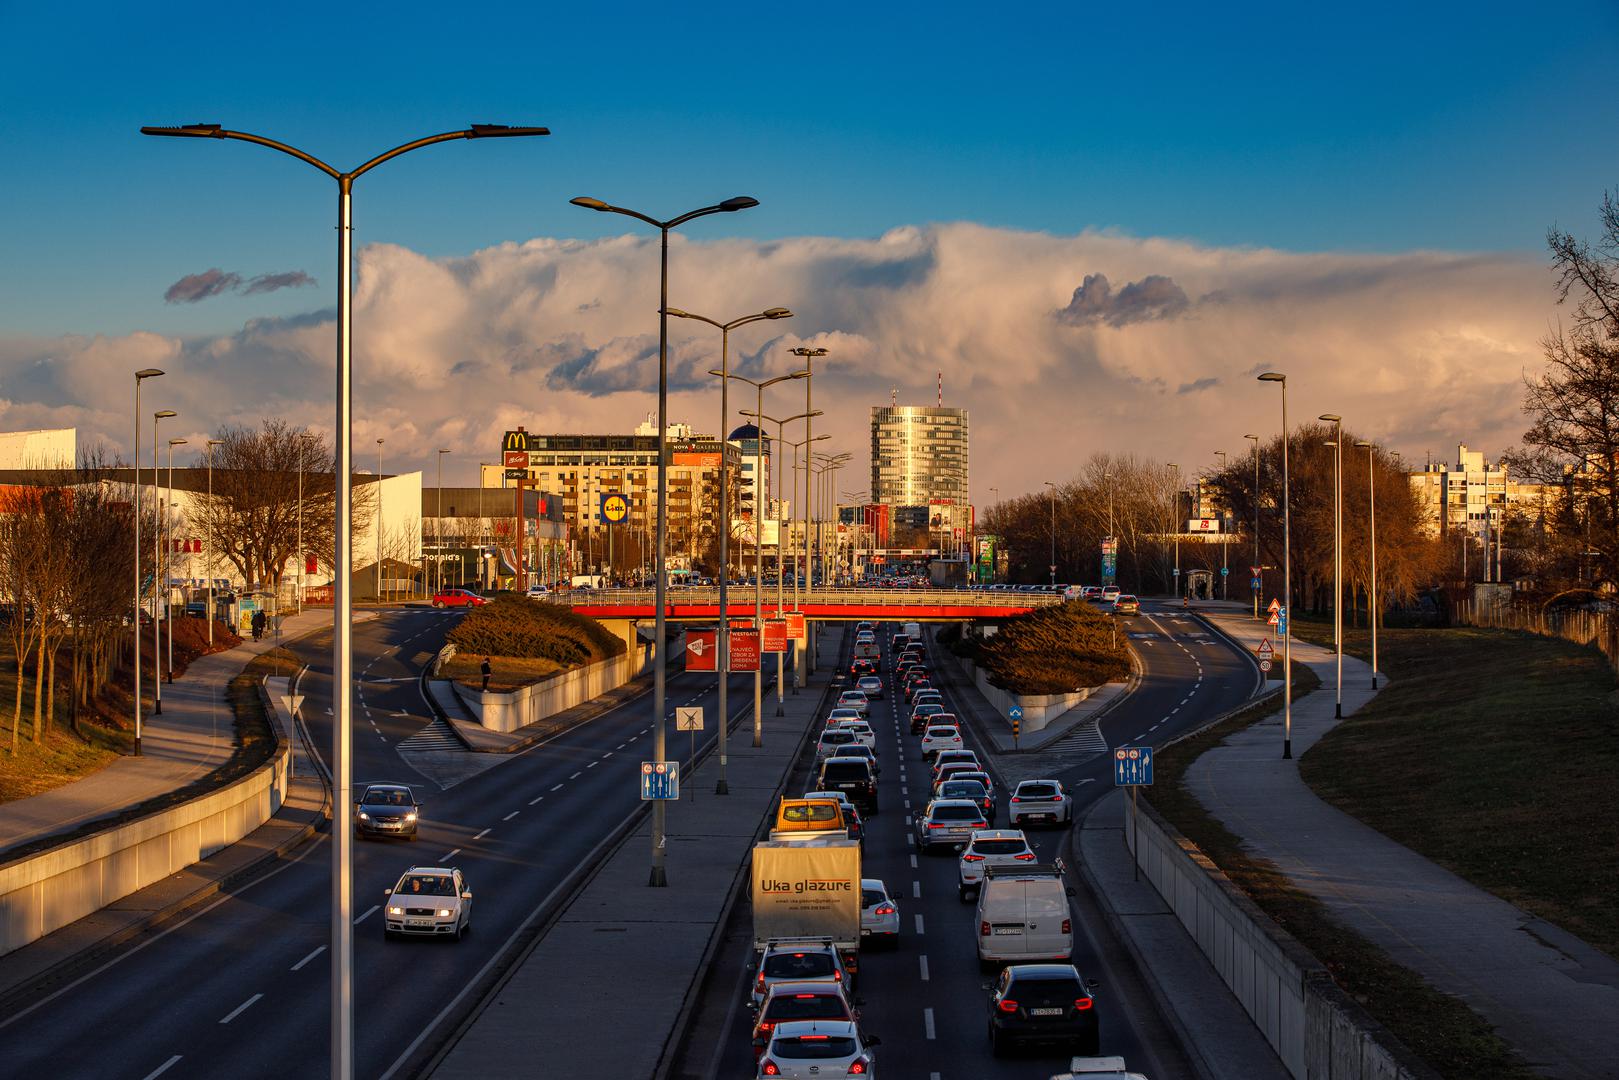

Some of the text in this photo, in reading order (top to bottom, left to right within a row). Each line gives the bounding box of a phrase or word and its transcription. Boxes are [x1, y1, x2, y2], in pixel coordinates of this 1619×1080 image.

[1261, 662, 1270, 670] 50
[762, 879, 851, 894] Uka glazure
